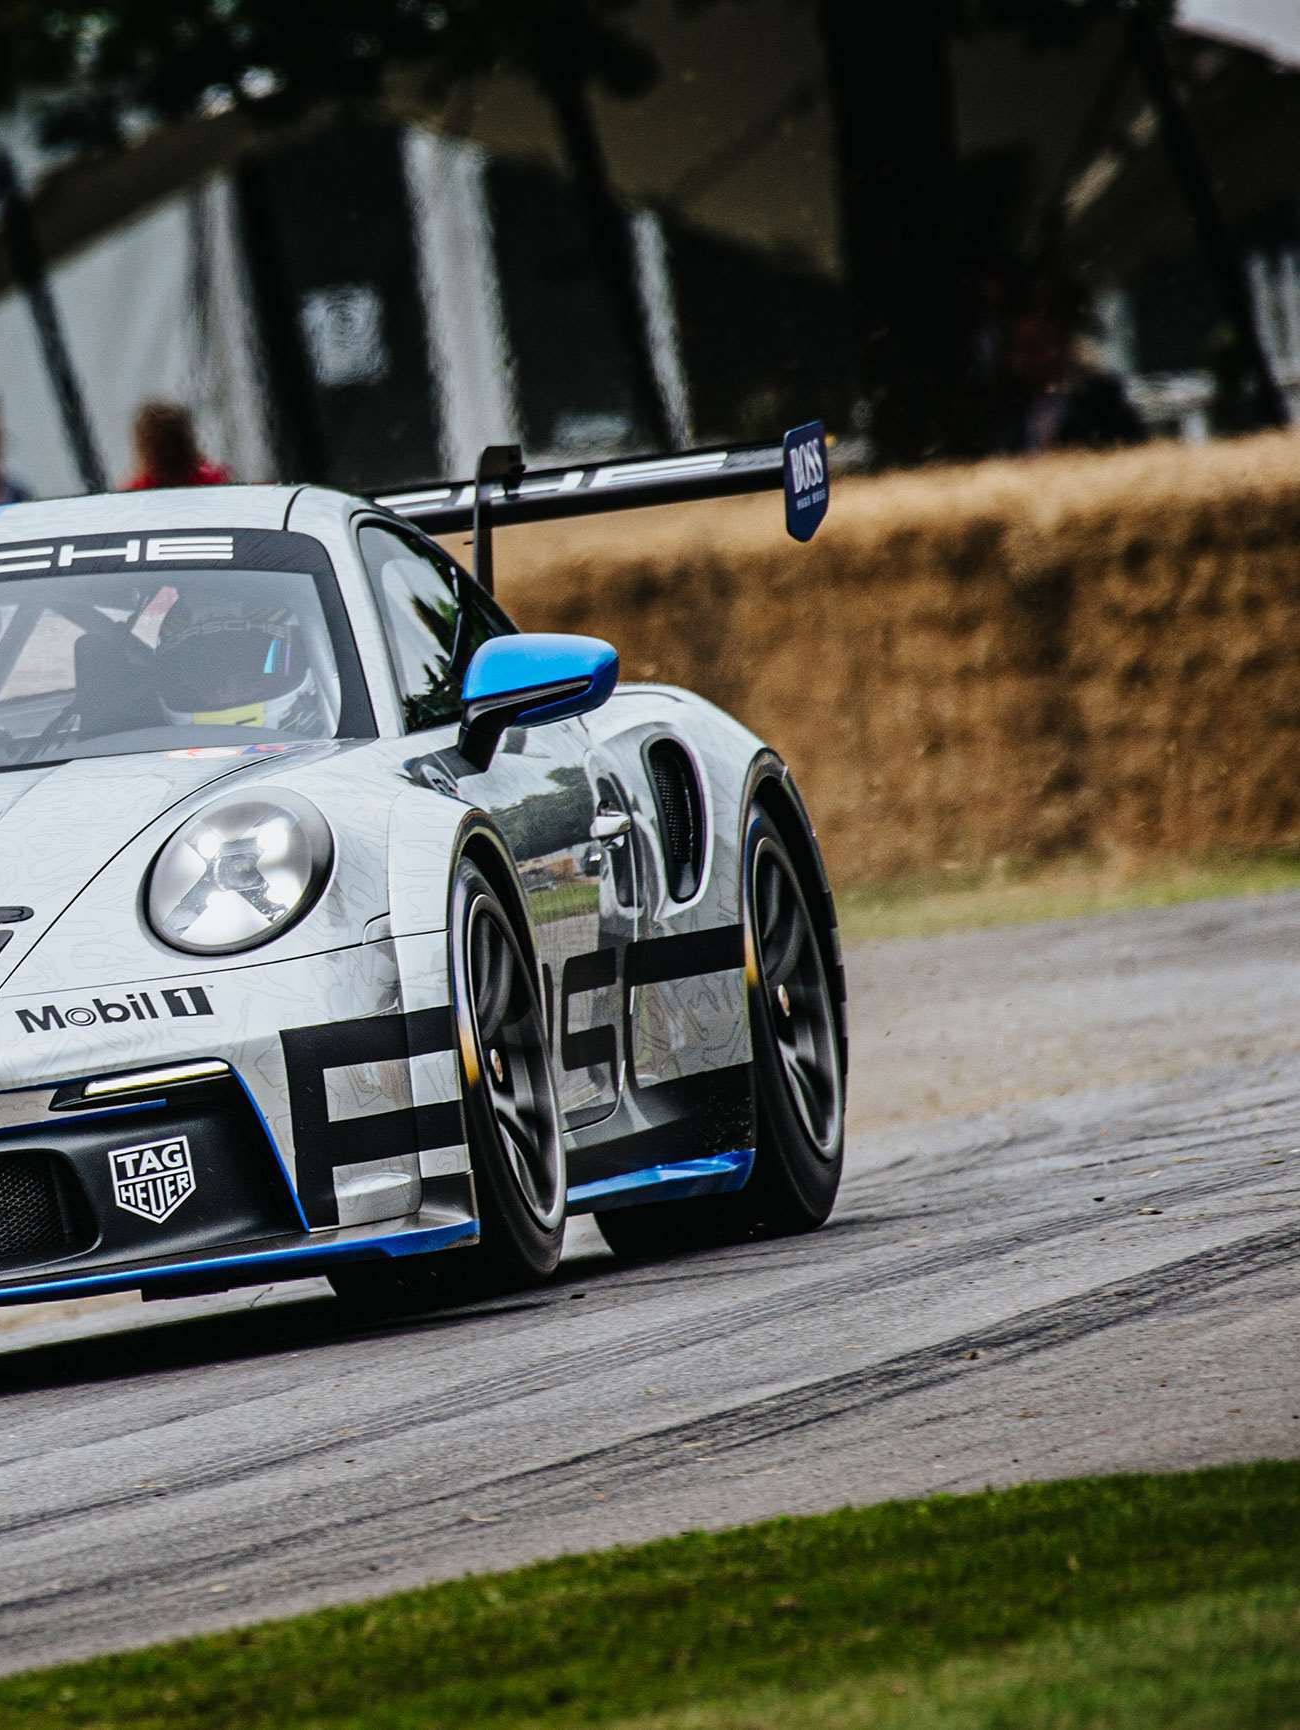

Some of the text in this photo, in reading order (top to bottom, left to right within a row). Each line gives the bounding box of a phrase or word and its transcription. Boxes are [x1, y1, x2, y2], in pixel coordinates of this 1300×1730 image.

[789, 437, 824, 494] BOSS
[15, 987, 203, 1034] Mobil 1
[116, 1144, 184, 1178] TAG
[120, 1173, 190, 1216] HEUER
